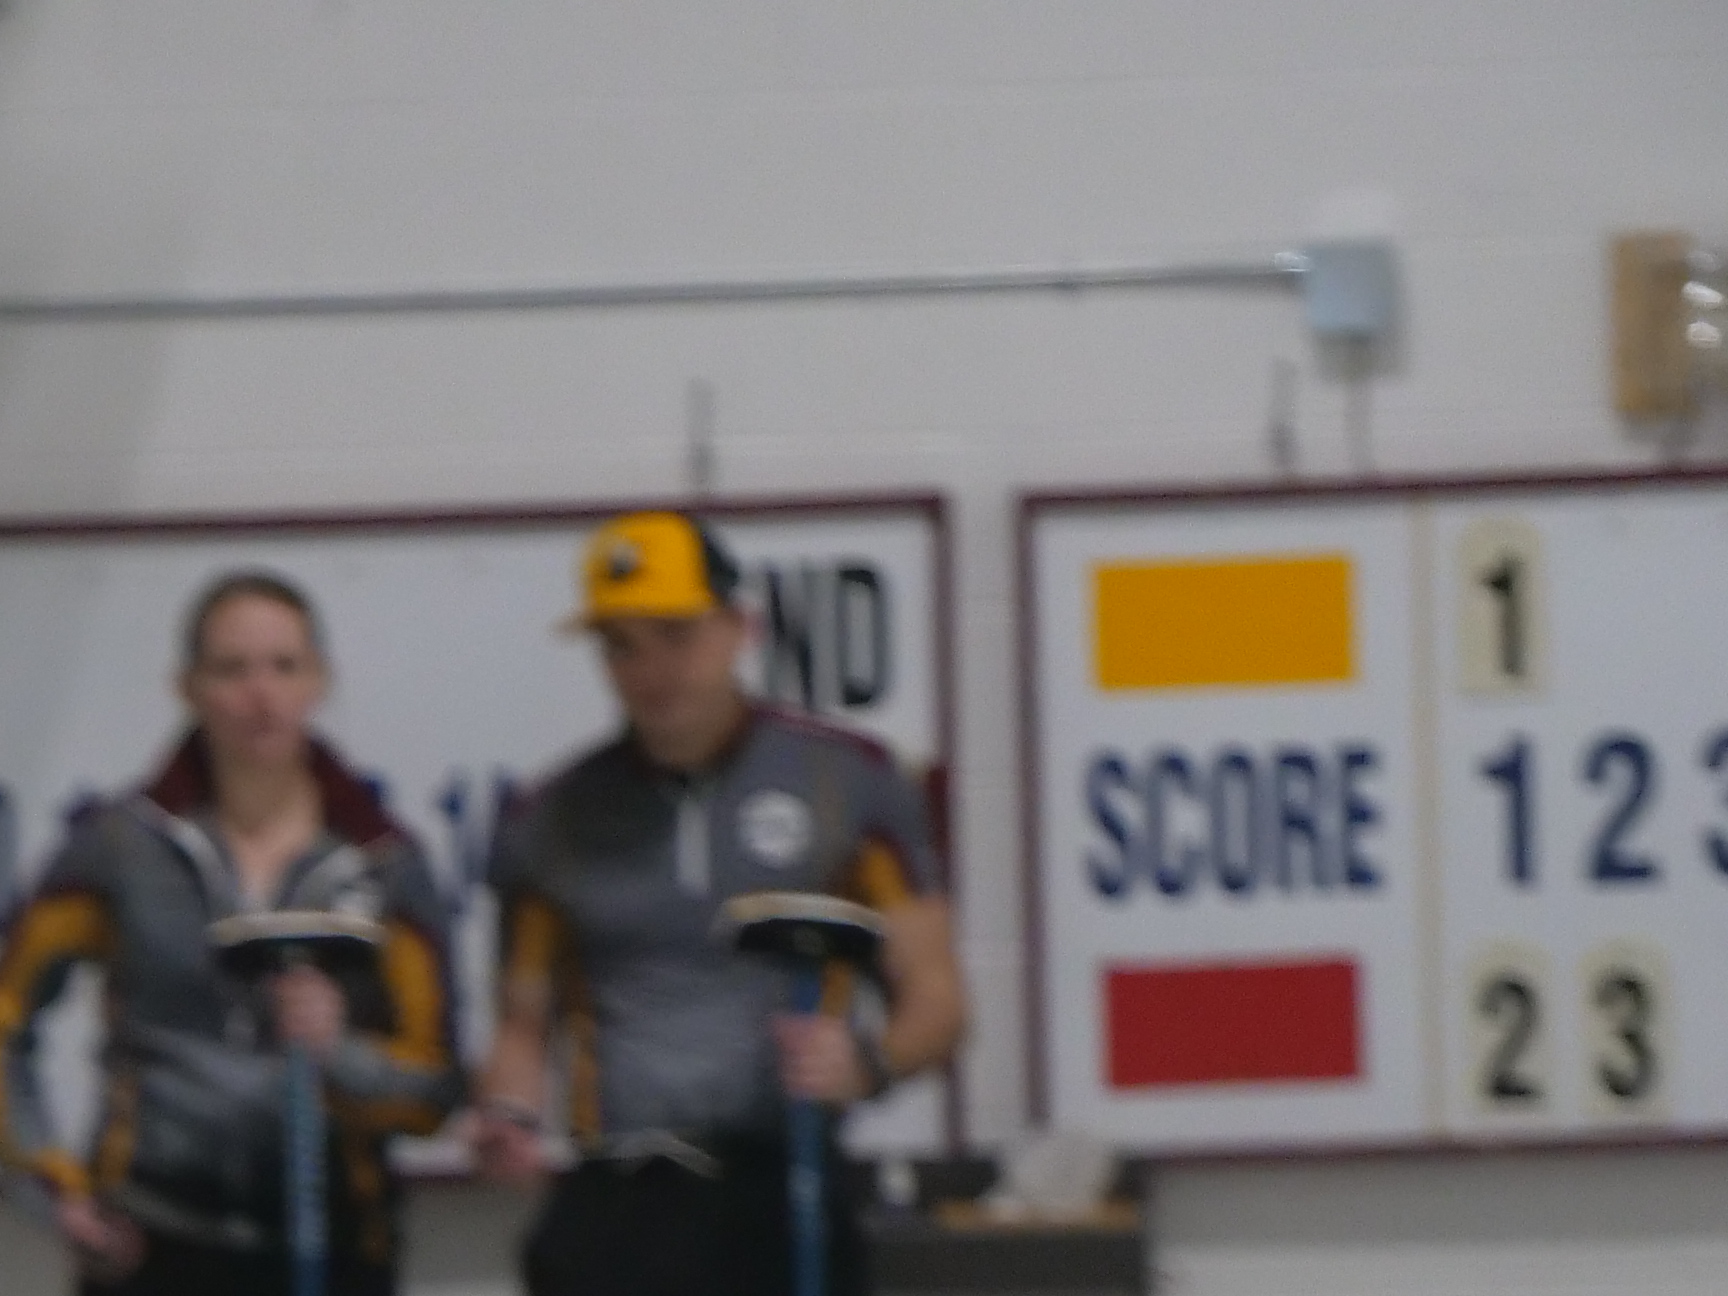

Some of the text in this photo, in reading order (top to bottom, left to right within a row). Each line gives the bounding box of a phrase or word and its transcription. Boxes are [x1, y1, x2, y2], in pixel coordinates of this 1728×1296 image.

[757, 561, 888, 714] ND
[1477, 548, 1527, 682] 1
[1083, 741, 1386, 904] SCORE
[1477, 731, 1538, 890] 1
[1580, 728, 1664, 891] 2
[1476, 965, 1661, 1108] 2 3
